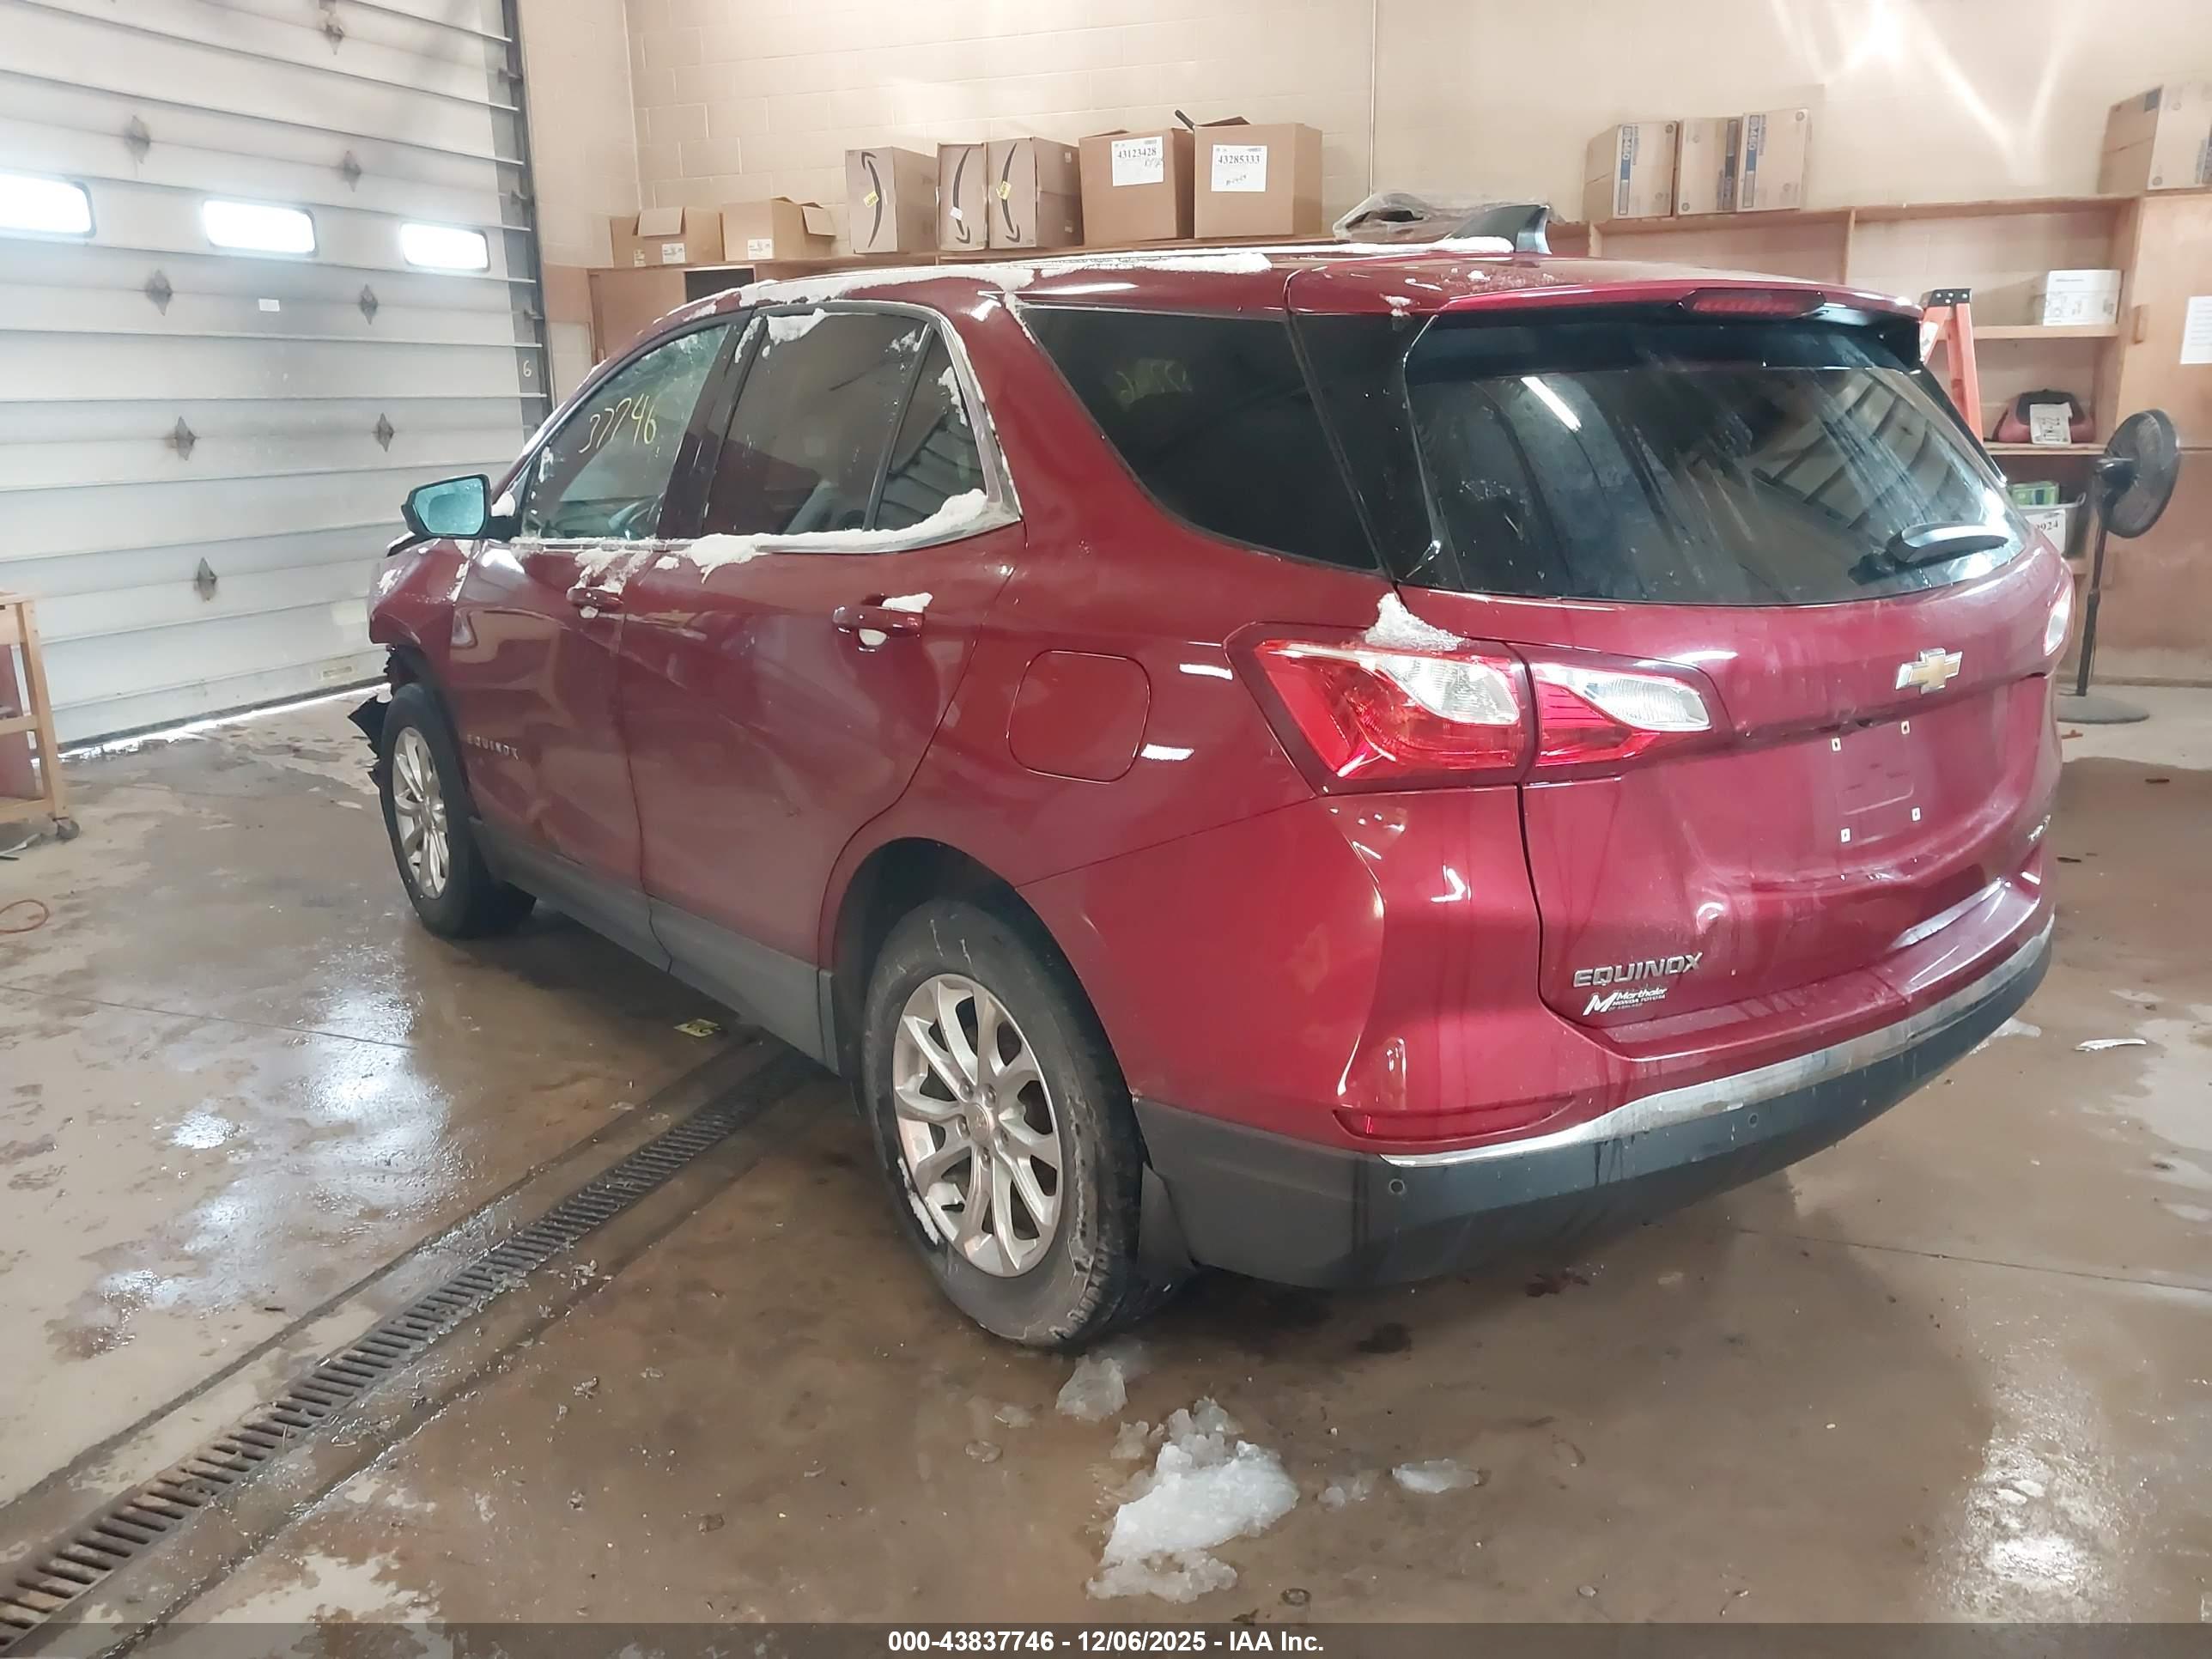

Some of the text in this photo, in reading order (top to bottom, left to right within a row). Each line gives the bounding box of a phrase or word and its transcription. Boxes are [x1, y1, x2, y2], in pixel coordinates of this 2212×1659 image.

[1116, 147, 1158, 159] 43123428
[1218, 155, 1261, 165] 43285333
[522, 358, 532, 378] 6
[577, 392, 659, 454] 37746
[466, 734, 520, 761] EQUINOX
[1572, 951, 1705, 988] EQUINOX
